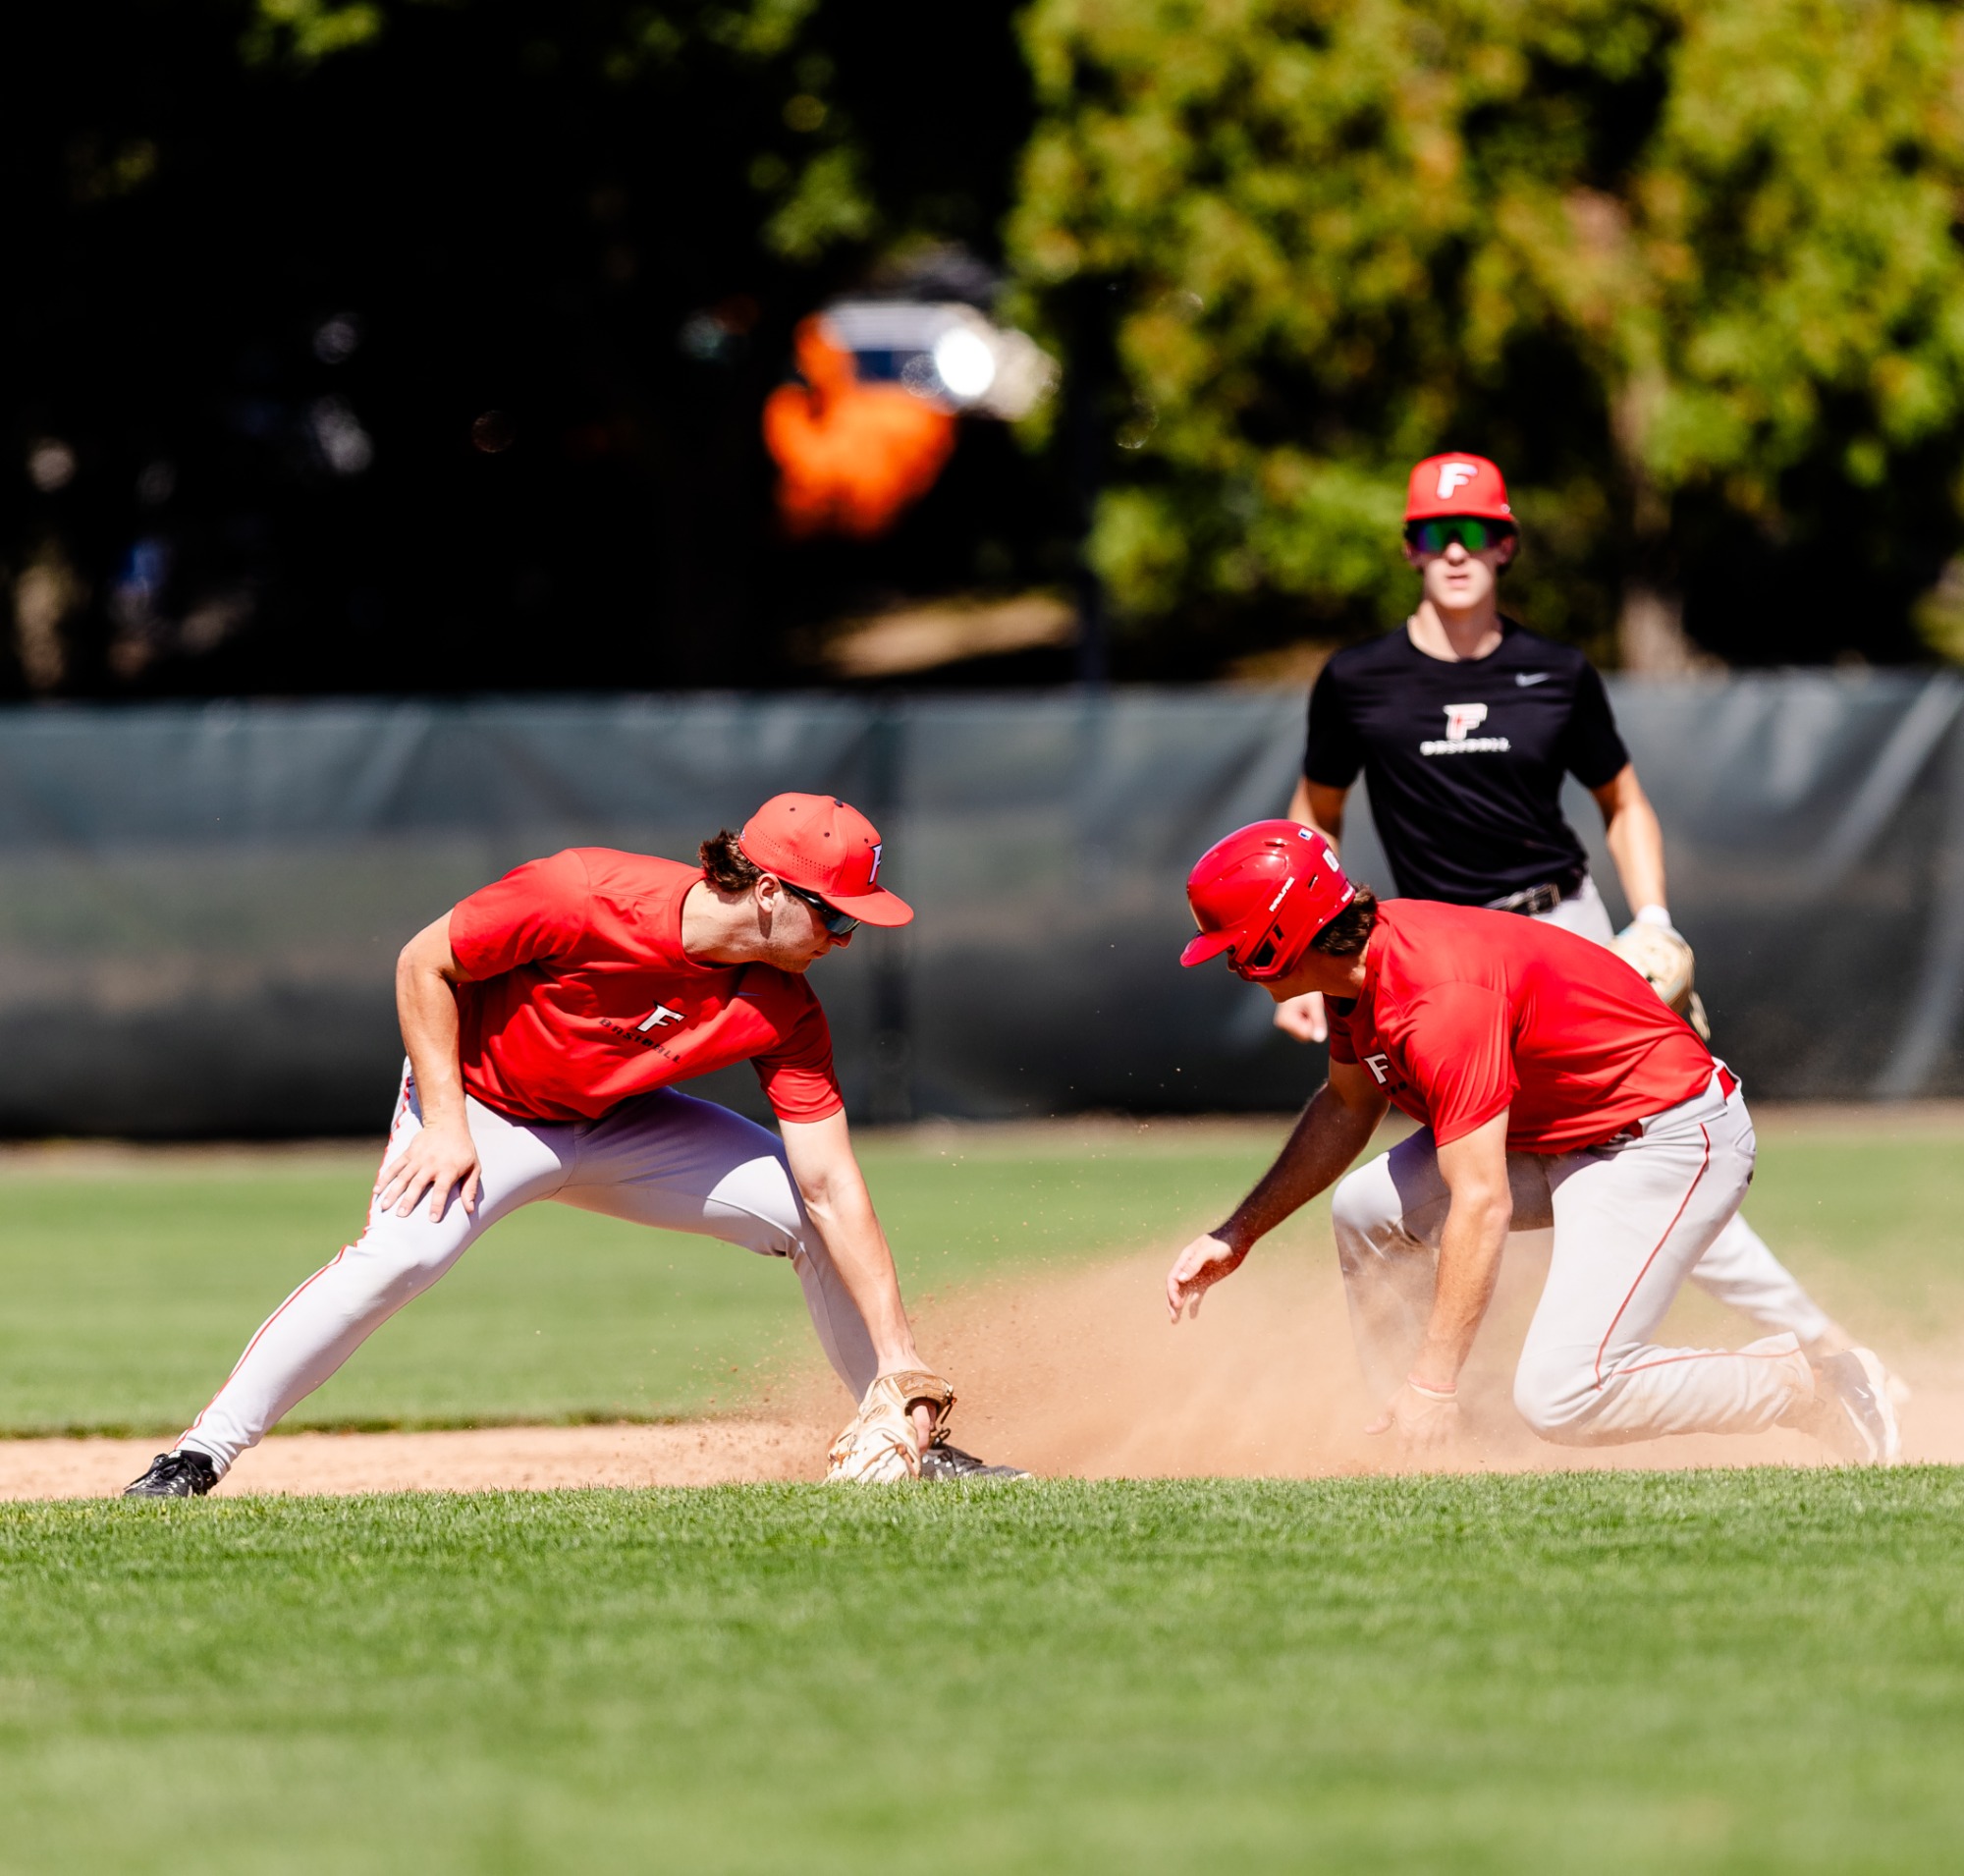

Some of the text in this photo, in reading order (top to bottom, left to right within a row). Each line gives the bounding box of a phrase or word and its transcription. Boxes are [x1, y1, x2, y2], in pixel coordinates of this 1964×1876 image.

[1437, 463, 1478, 500] F
[1443, 702, 1488, 741] F
[634, 1001, 686, 1033] F
[1362, 1052, 1390, 1085] F
